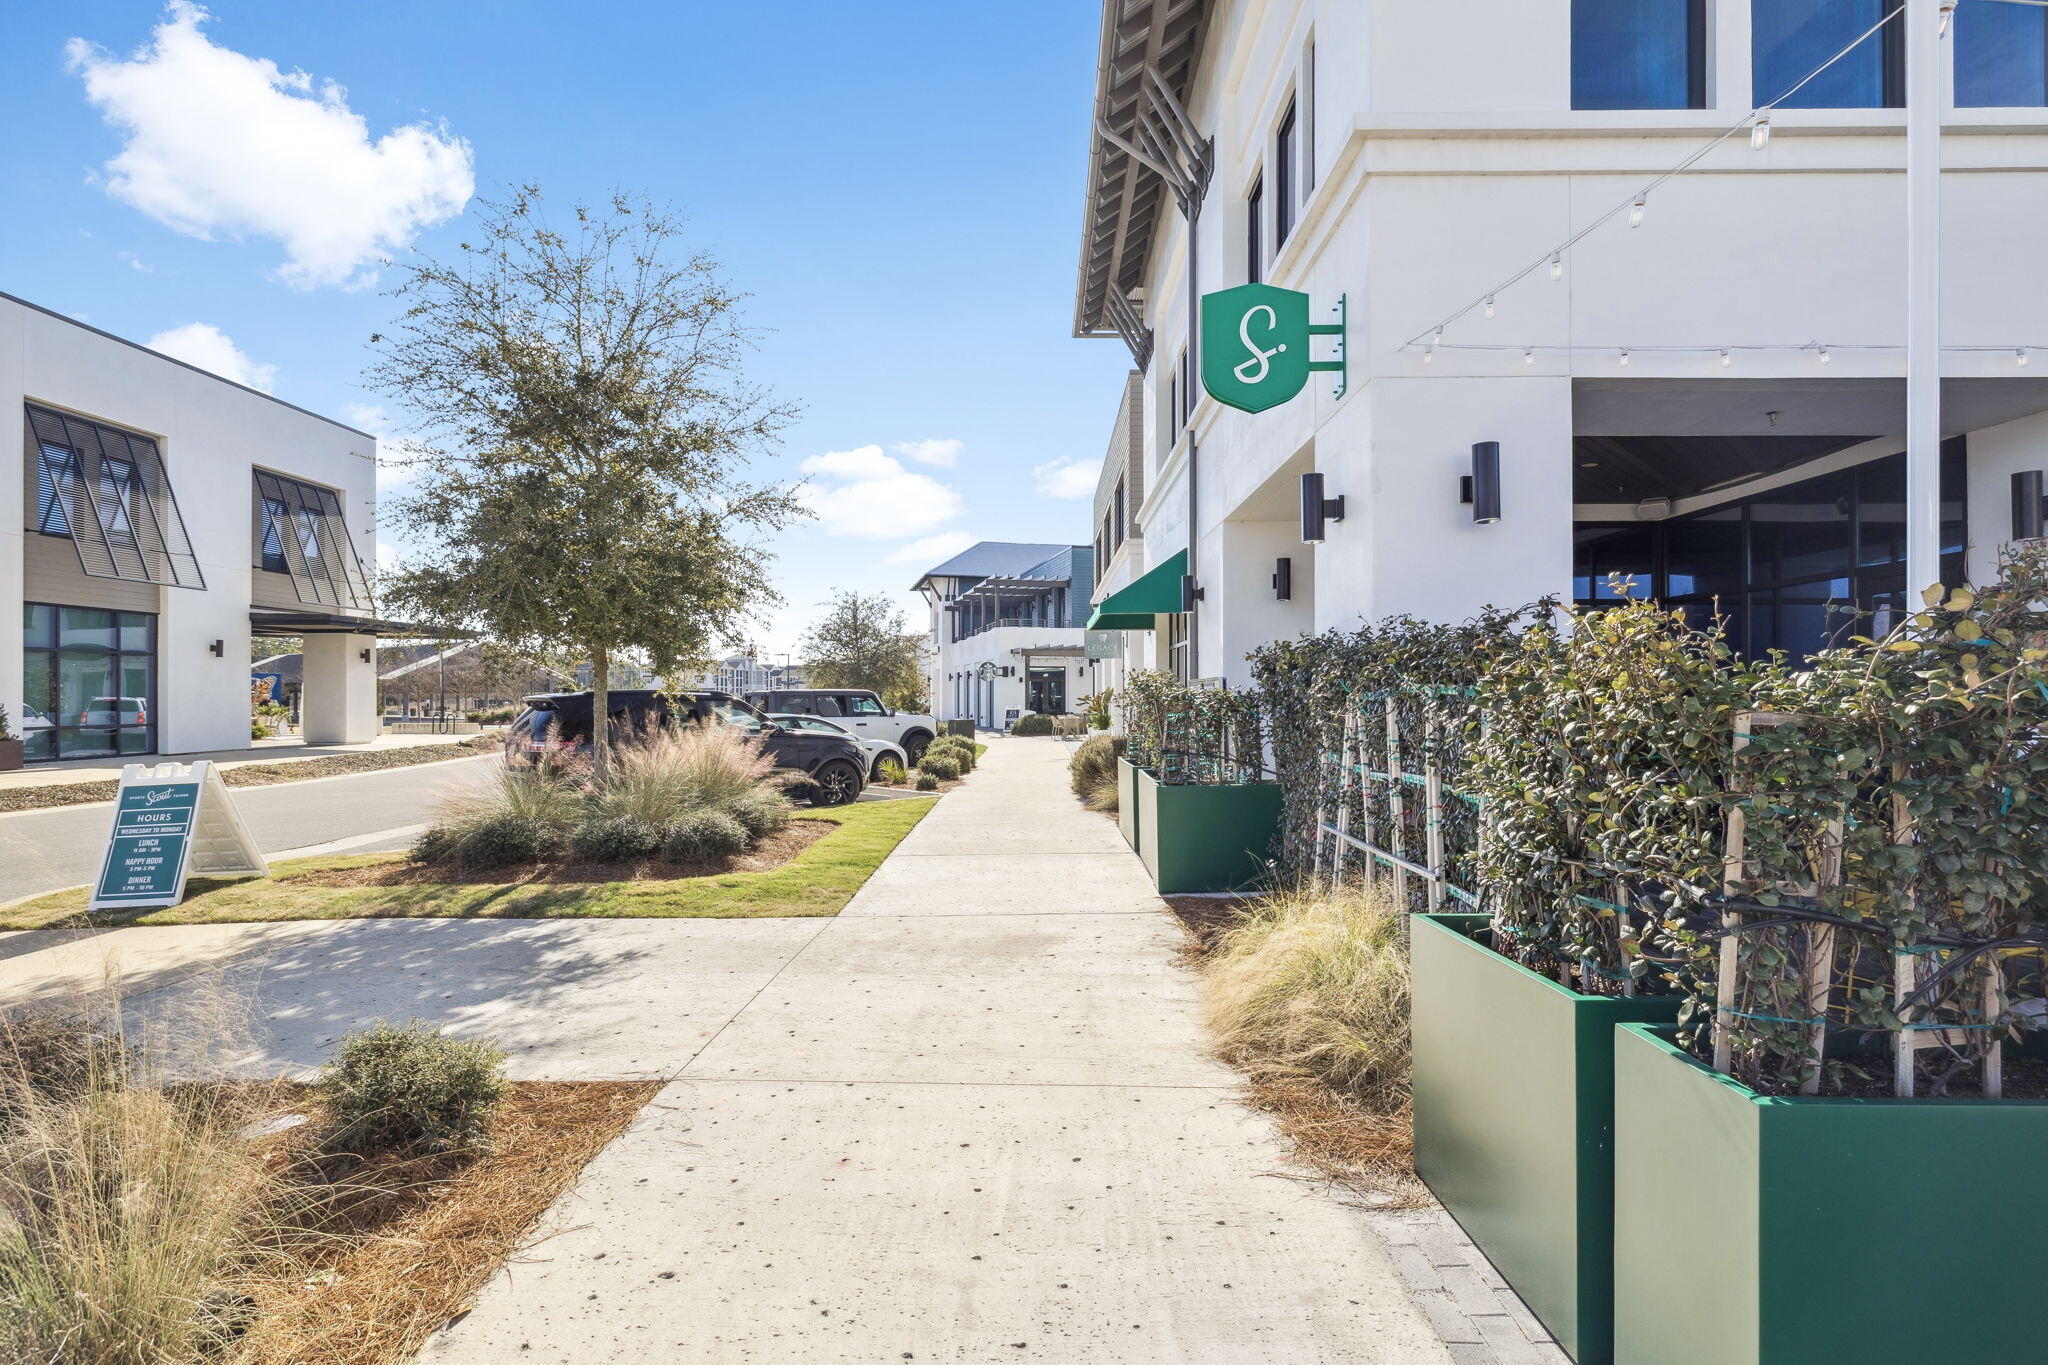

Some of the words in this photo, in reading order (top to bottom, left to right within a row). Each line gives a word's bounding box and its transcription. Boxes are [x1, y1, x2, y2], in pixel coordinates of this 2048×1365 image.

[1087, 644, 1118, 652] LEGACY
[145, 787, 175, 806] Scout
[137, 813, 172, 823] HOURS
[121, 827, 152, 835] WEDNESDAY
[138, 839, 160, 847] LUNCH
[125, 858, 145, 866] HAPPY
[146, 857, 164, 865] HOUR
[128, 876, 152, 884] DINNER
